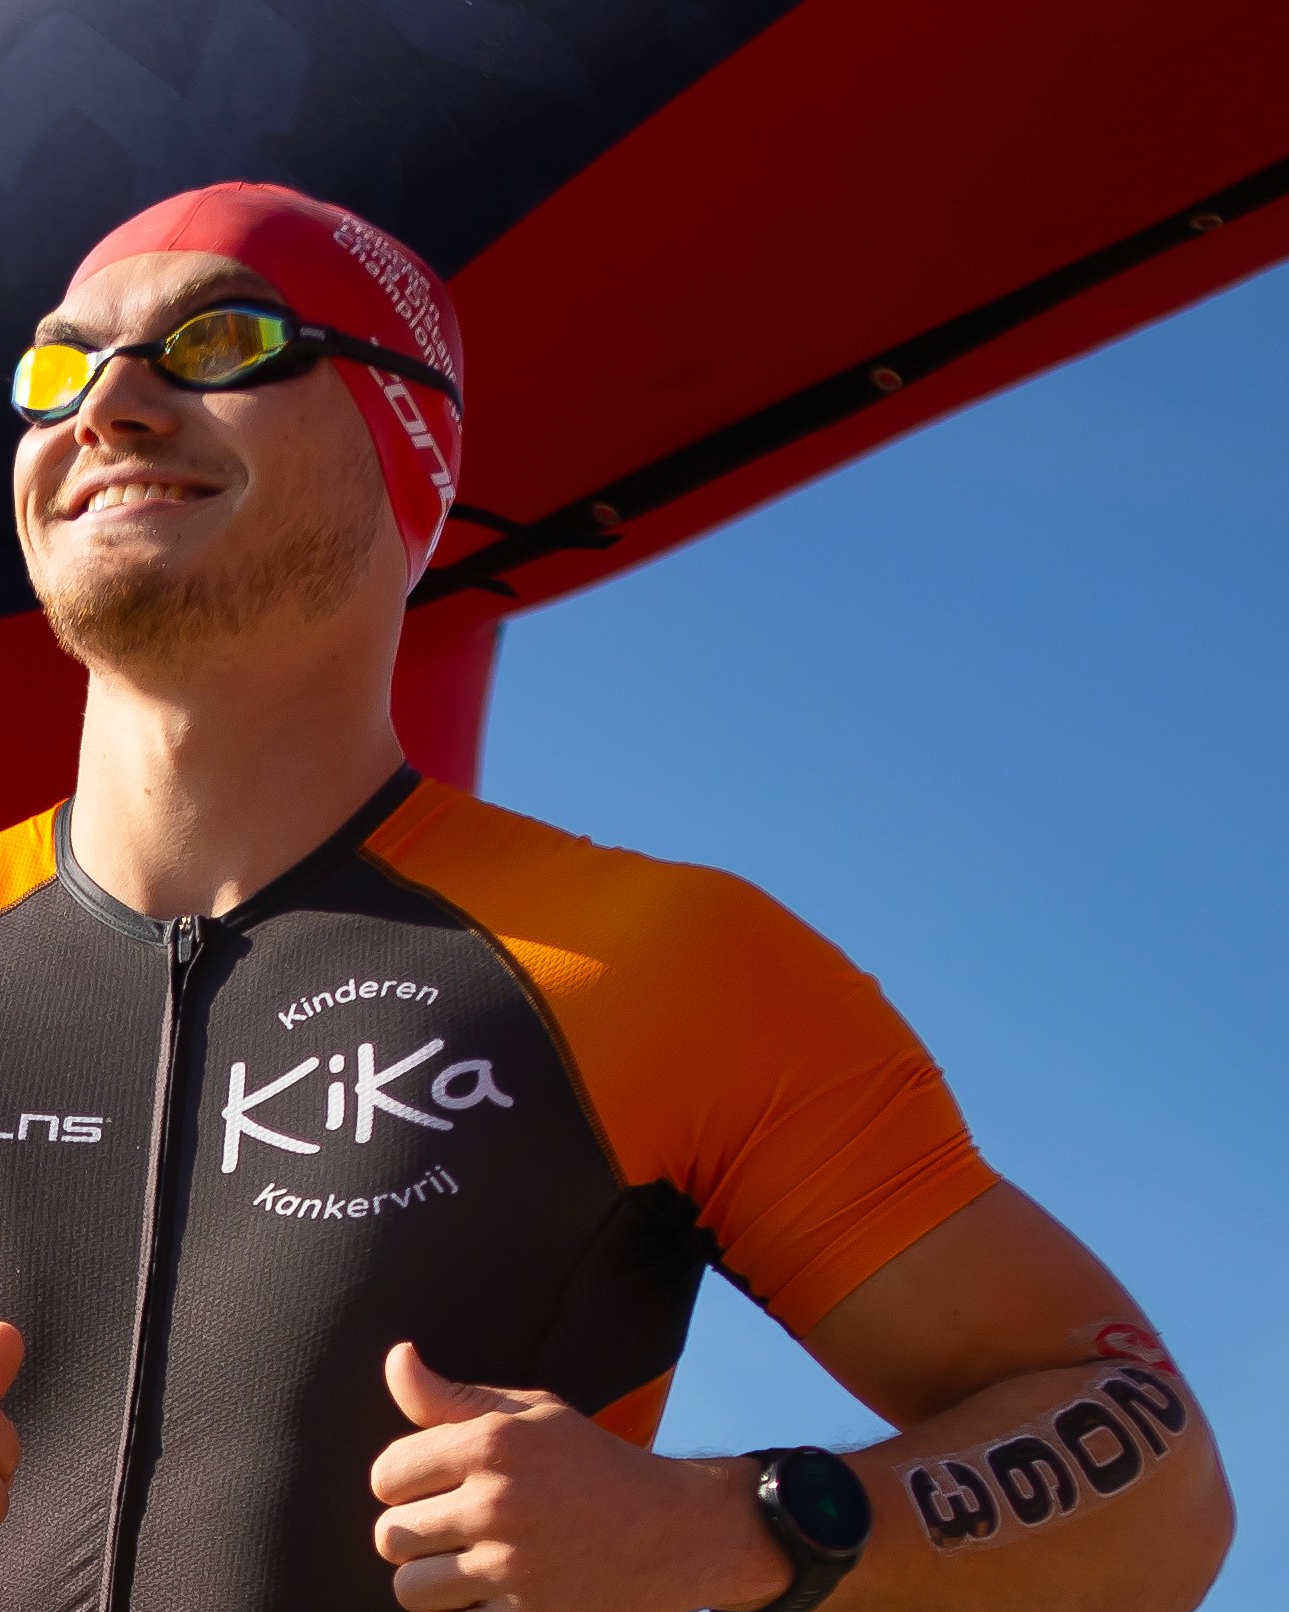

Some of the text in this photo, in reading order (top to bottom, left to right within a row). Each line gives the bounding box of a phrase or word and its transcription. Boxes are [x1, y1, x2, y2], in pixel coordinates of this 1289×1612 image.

[278, 977, 439, 1031] Kinderen
[220, 1038, 514, 1174] KiKa
[253, 1165, 460, 1220] Kankervrij
